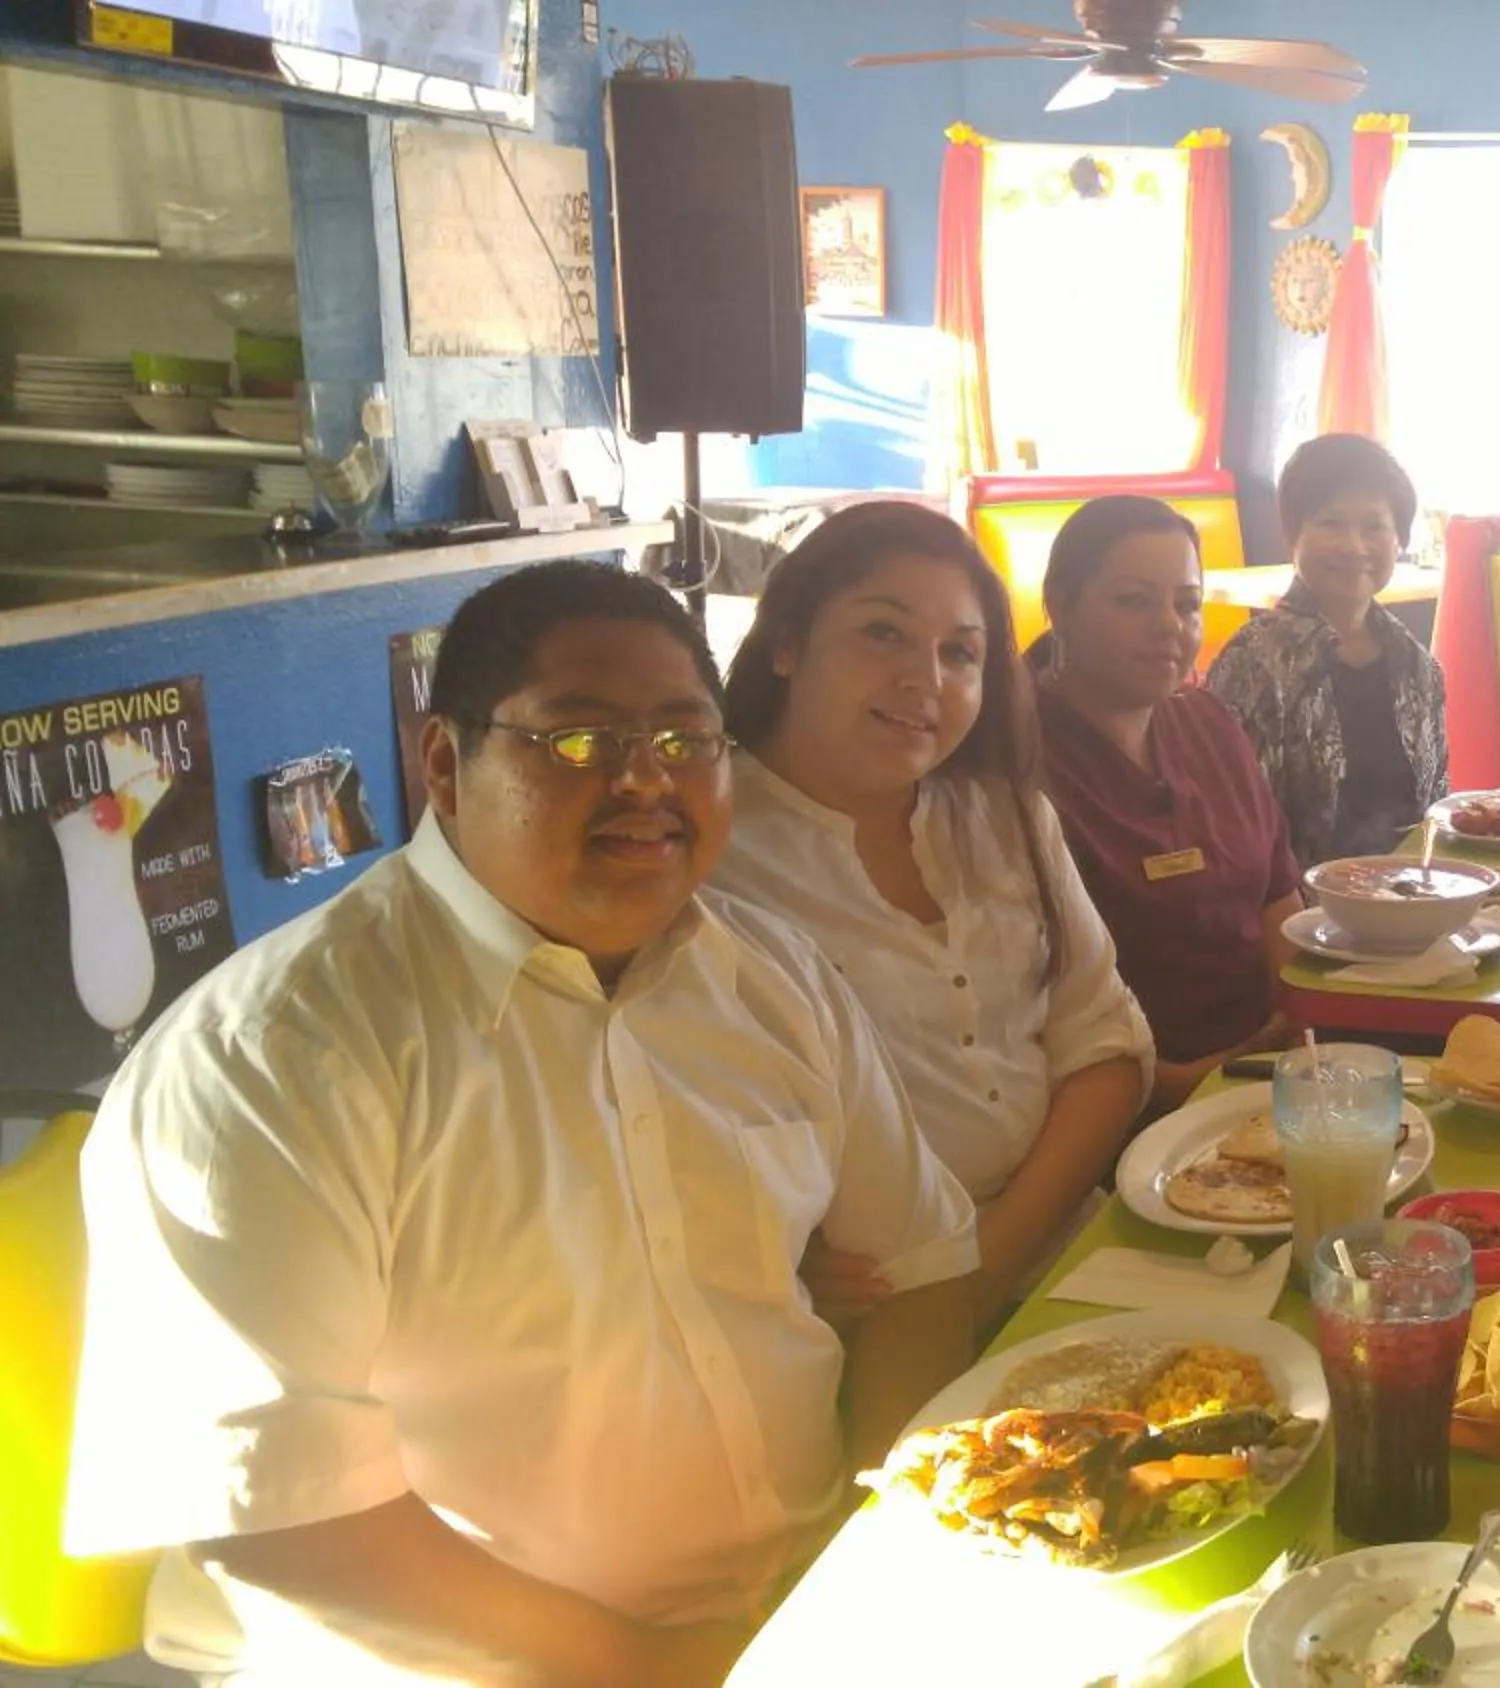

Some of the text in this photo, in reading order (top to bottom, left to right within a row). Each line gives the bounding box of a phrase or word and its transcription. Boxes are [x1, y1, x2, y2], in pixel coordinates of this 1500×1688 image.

[0, 687, 181, 749] OW SERVING
[0, 748, 47, 816] ÑA
[65, 719, 192, 800] CODAS
[179, 842, 211, 868] WITH
[175, 929, 206, 953] RUM
